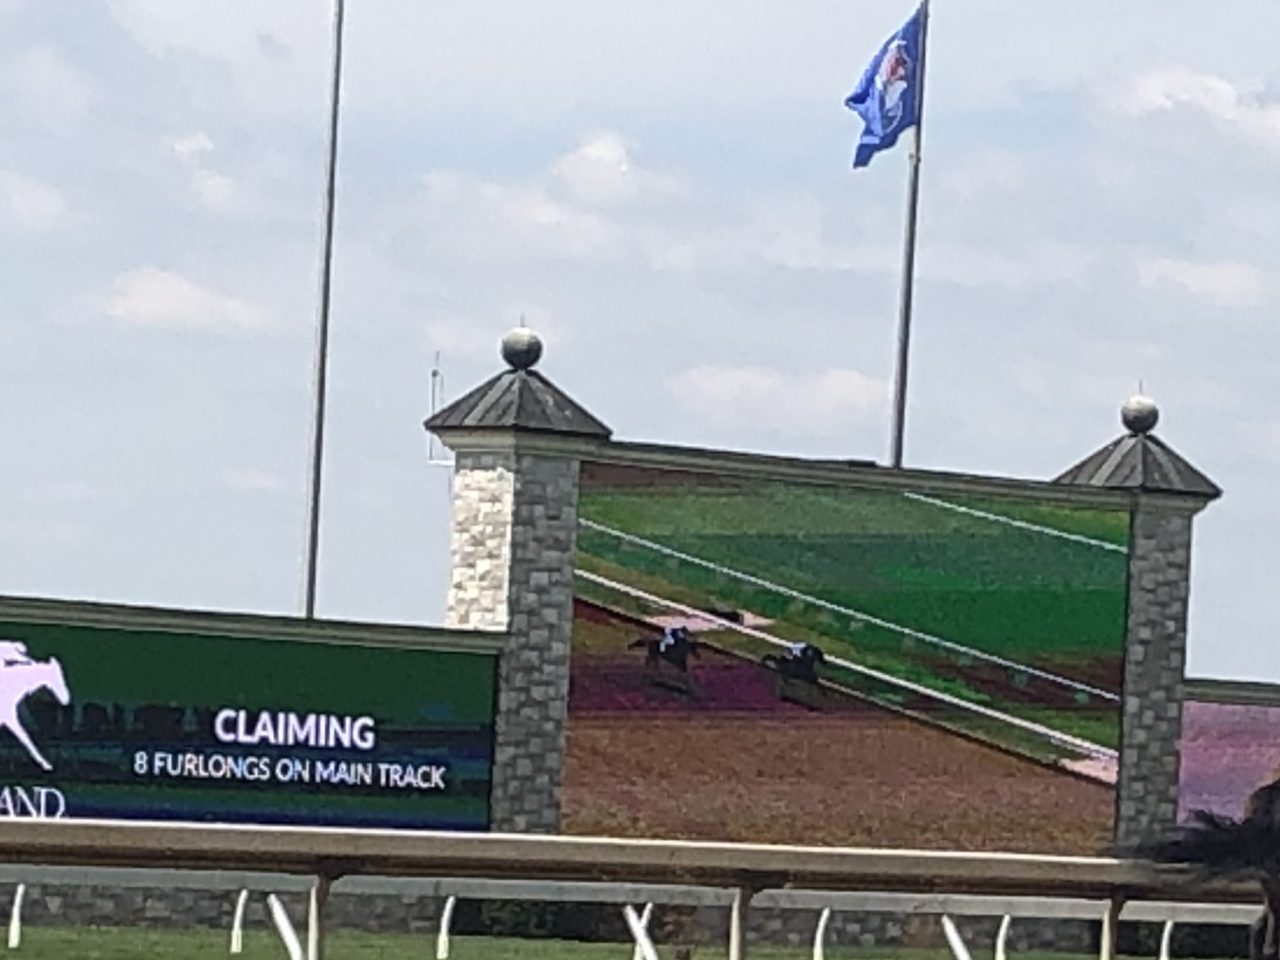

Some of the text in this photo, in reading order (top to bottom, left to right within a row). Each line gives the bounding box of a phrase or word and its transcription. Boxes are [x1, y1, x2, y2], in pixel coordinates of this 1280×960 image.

[214, 708, 376, 750] CLAIMING
[133, 751, 447, 789] 8 FURLONGS ON MAIN TRACK
